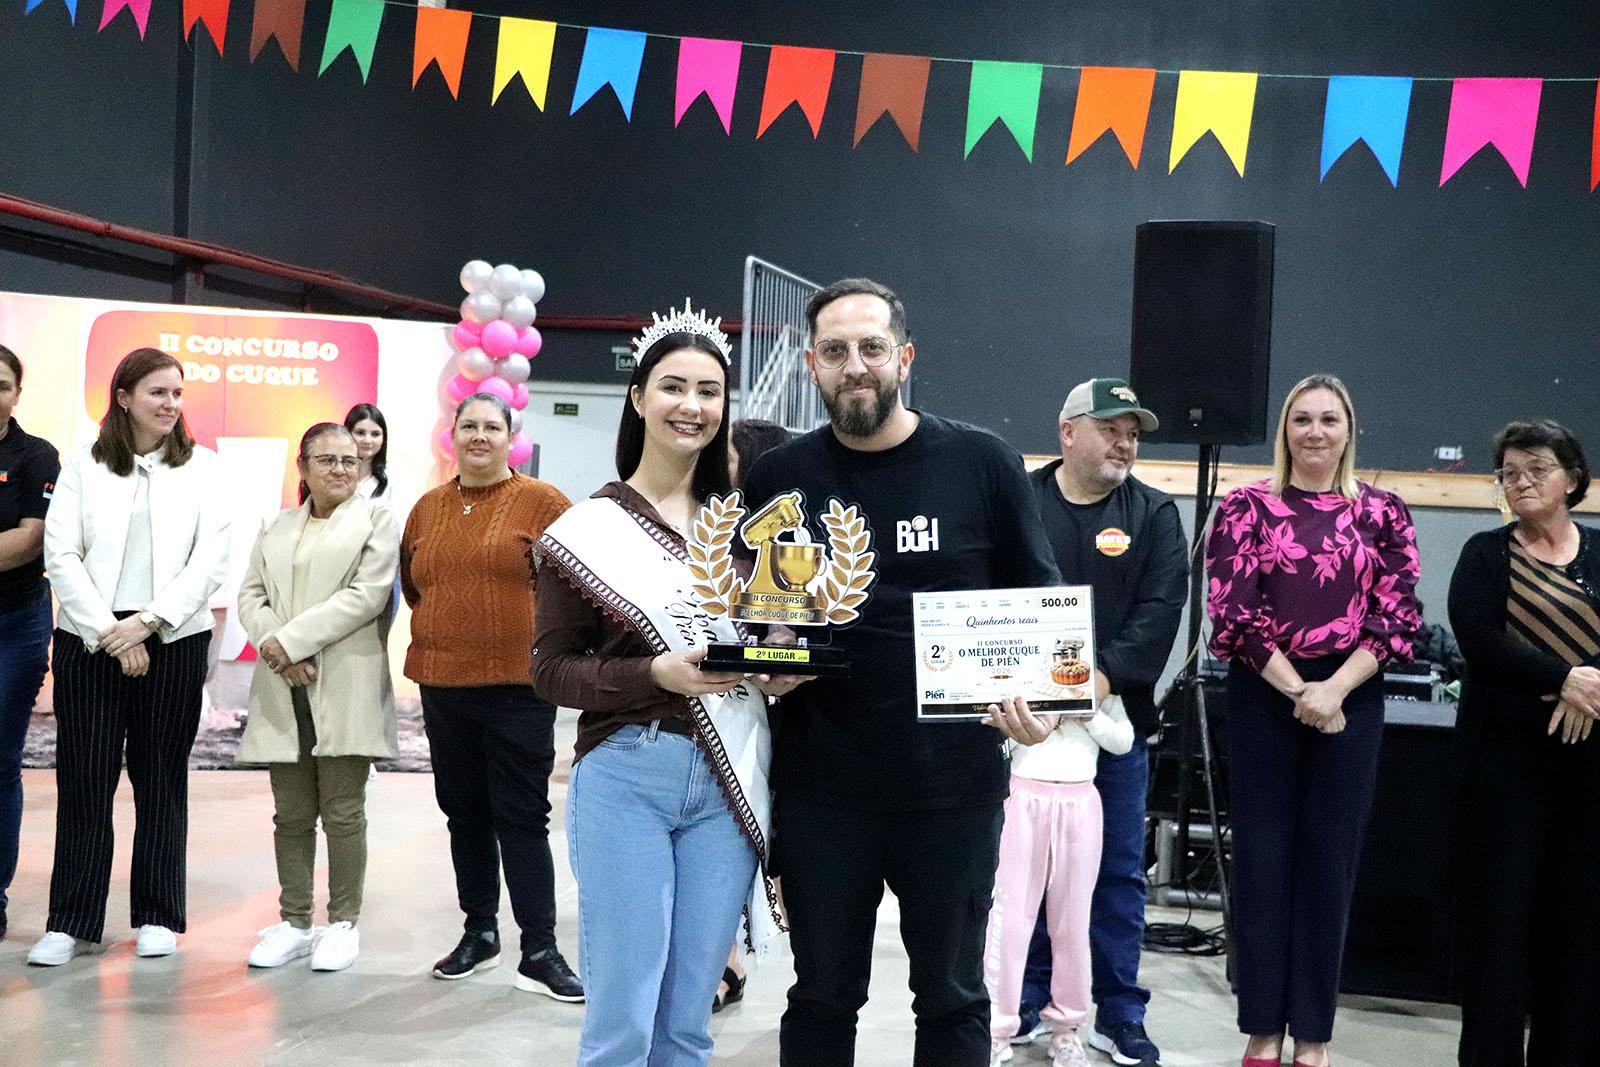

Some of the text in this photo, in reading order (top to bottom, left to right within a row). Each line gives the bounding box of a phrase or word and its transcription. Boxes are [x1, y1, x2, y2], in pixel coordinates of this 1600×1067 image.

[159, 332, 340, 361] II CONCURSO
[183, 361, 320, 386] DO CUQUE
[760, 594, 807, 604] CONCURSO
[1041, 597, 1078, 608] 500,00
[790, 611, 798, 619] DE
[966, 615, 1039, 628] Quinhentos reais
[768, 651, 796, 660] LUGAR
[958, 645, 1040, 658] O MELHOR CUQUE
[981, 655, 1020, 667] DE PIÊN
